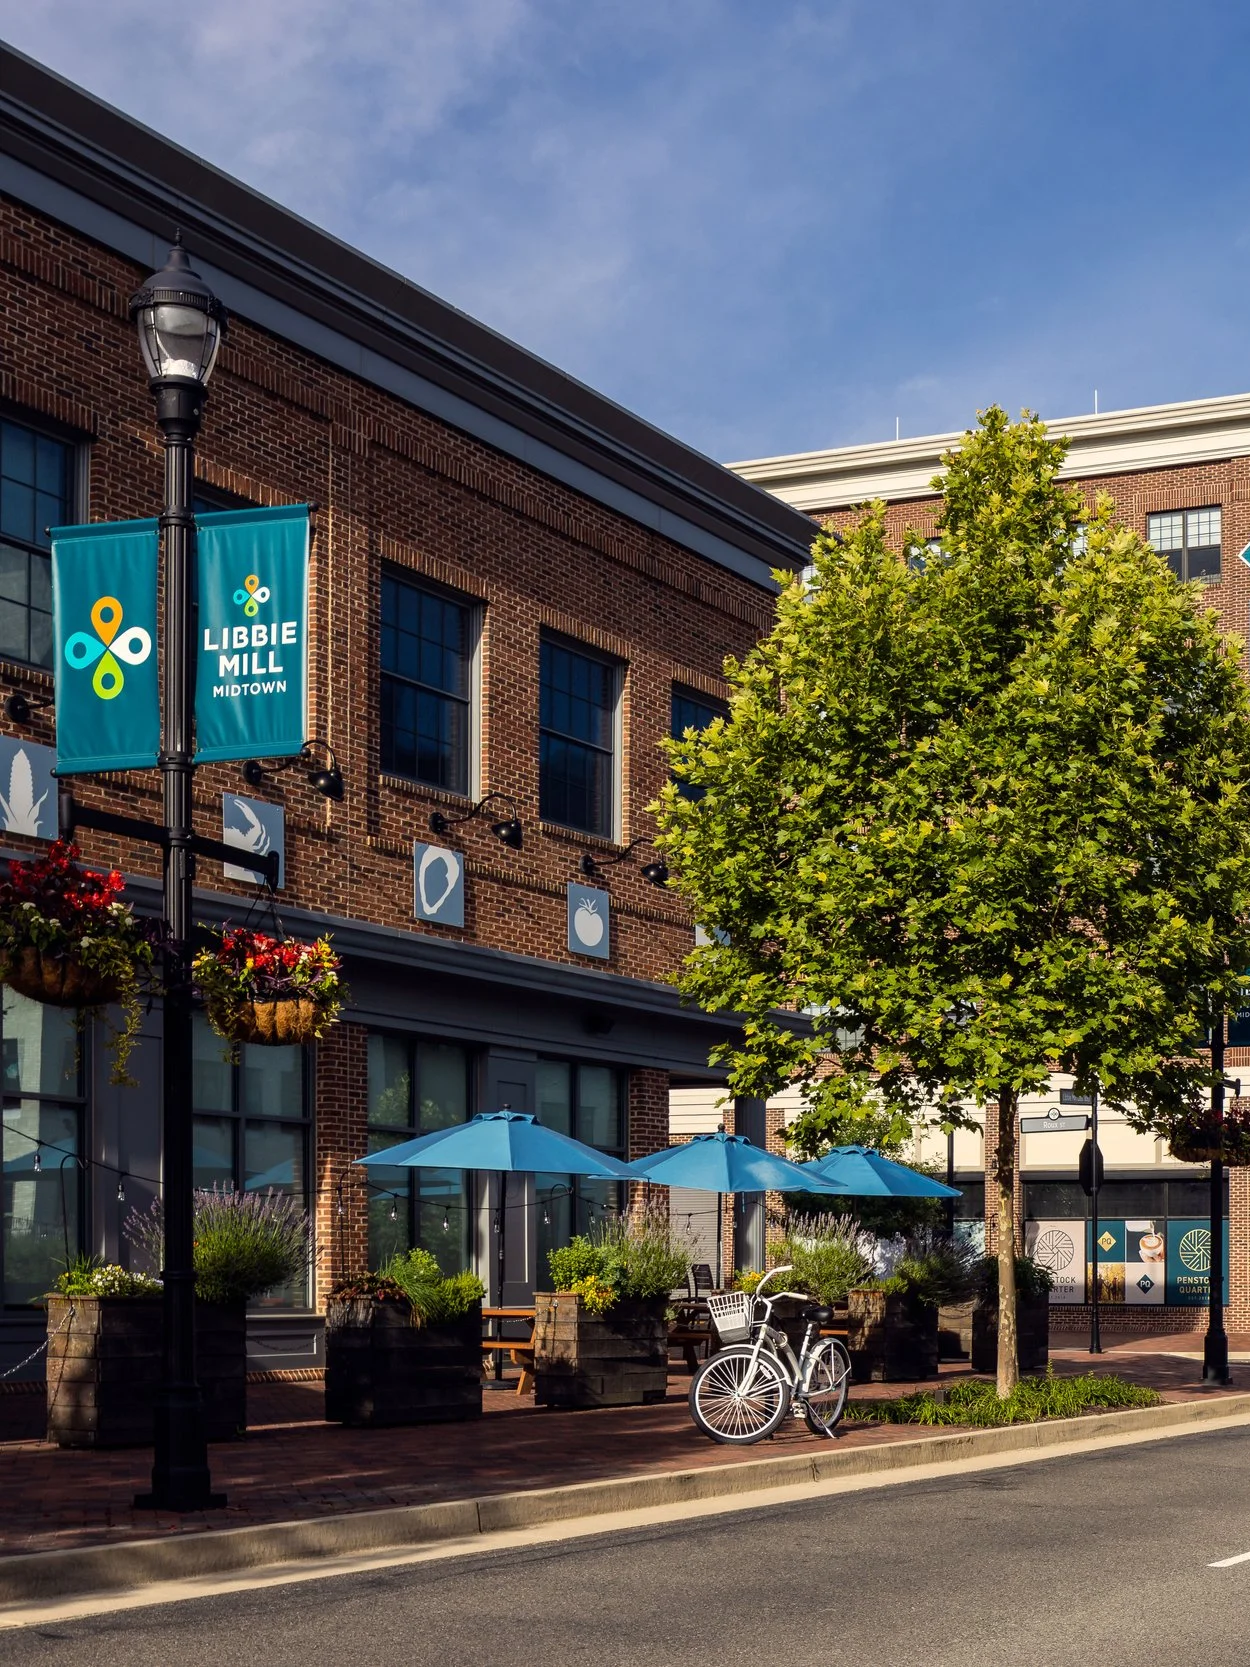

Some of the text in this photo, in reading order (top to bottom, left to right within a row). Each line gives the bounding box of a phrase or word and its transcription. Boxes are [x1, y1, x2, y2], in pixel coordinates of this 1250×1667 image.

[203, 621, 297, 651] LIBBIE
[218, 651, 284, 678] MILL
[212, 680, 287, 698] MIDTOWN
[1043, 1121, 1058, 1129] Roux
[1101, 1237, 1112, 1245] PQ
[1140, 1280, 1151, 1288] PQ
[1177, 1276, 1210, 1284] PENSTO
[1179, 1286, 1210, 1294] QUART
